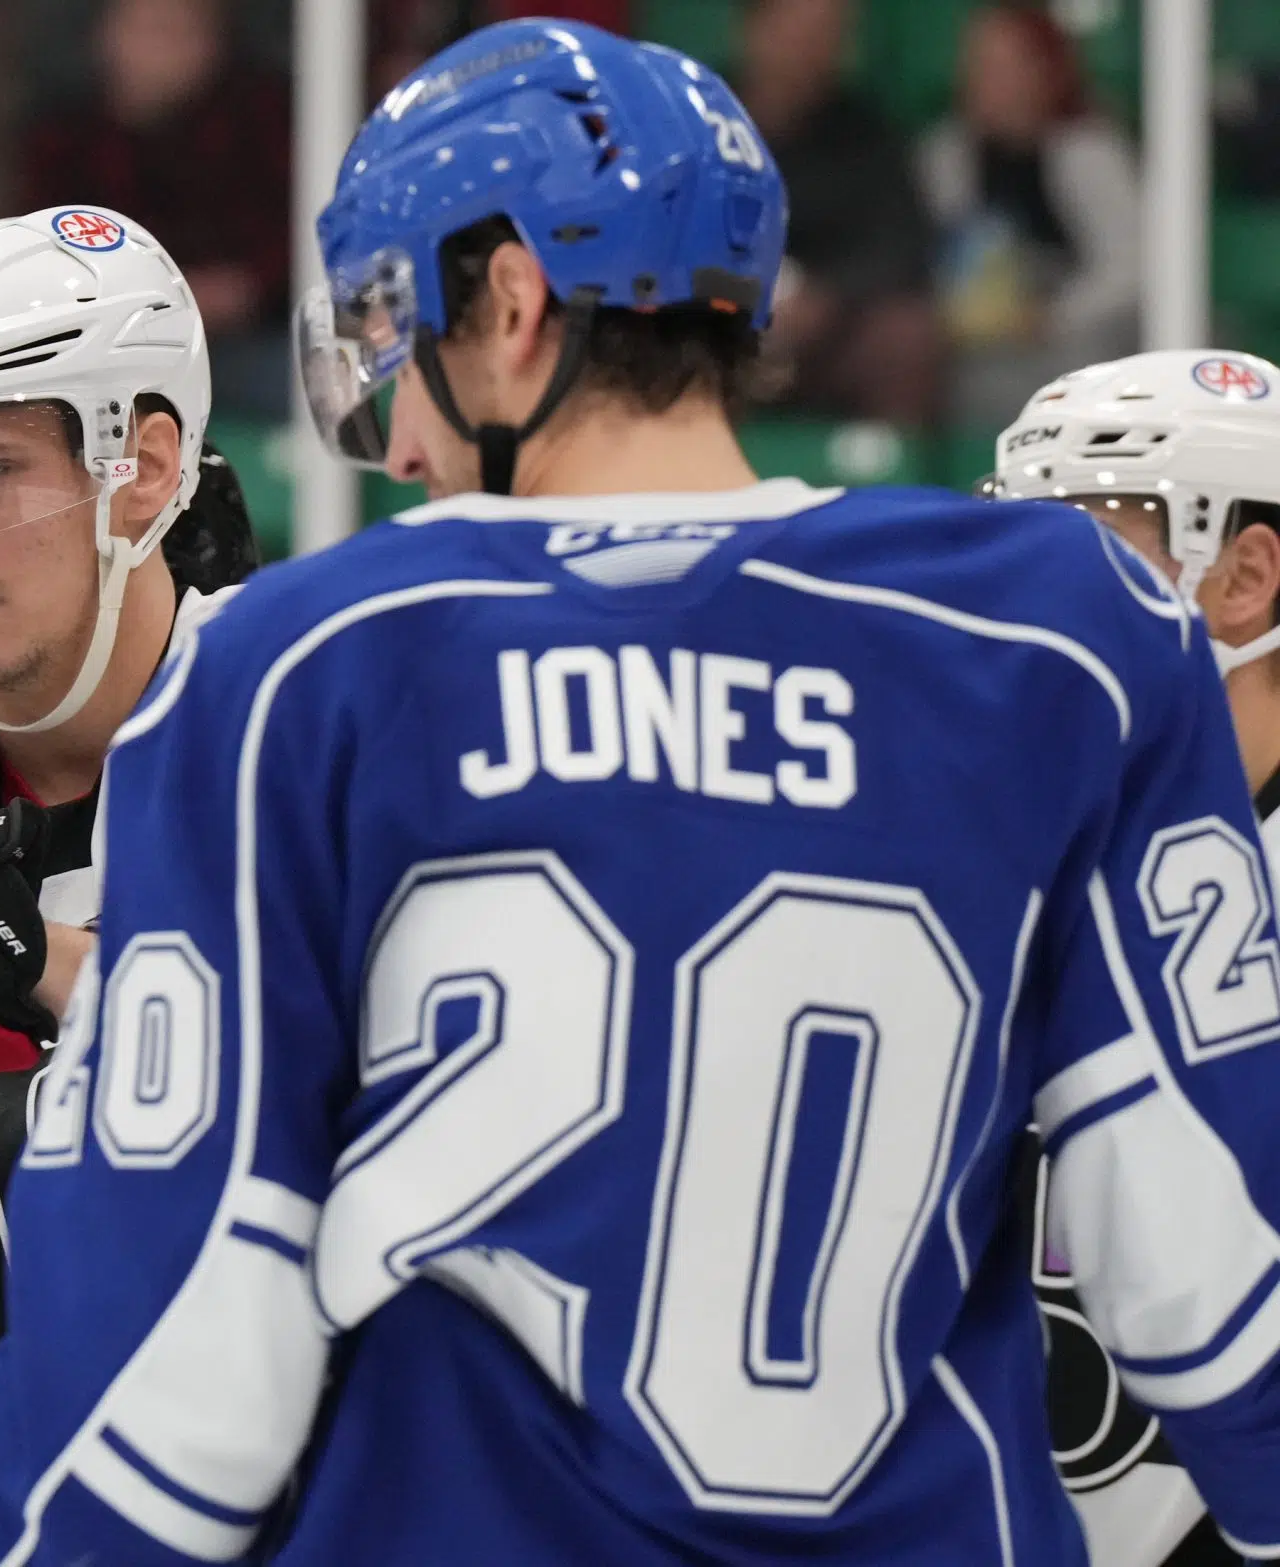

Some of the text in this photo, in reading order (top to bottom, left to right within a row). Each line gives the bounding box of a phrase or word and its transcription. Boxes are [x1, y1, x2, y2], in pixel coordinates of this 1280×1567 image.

[60, 214, 118, 246] CAA
[1200, 360, 1259, 394] CAA
[1006, 423, 1063, 453] CCM
[458, 645, 857, 808] JONES
[19, 930, 220, 1169] 20
[309, 849, 982, 1516] 20
